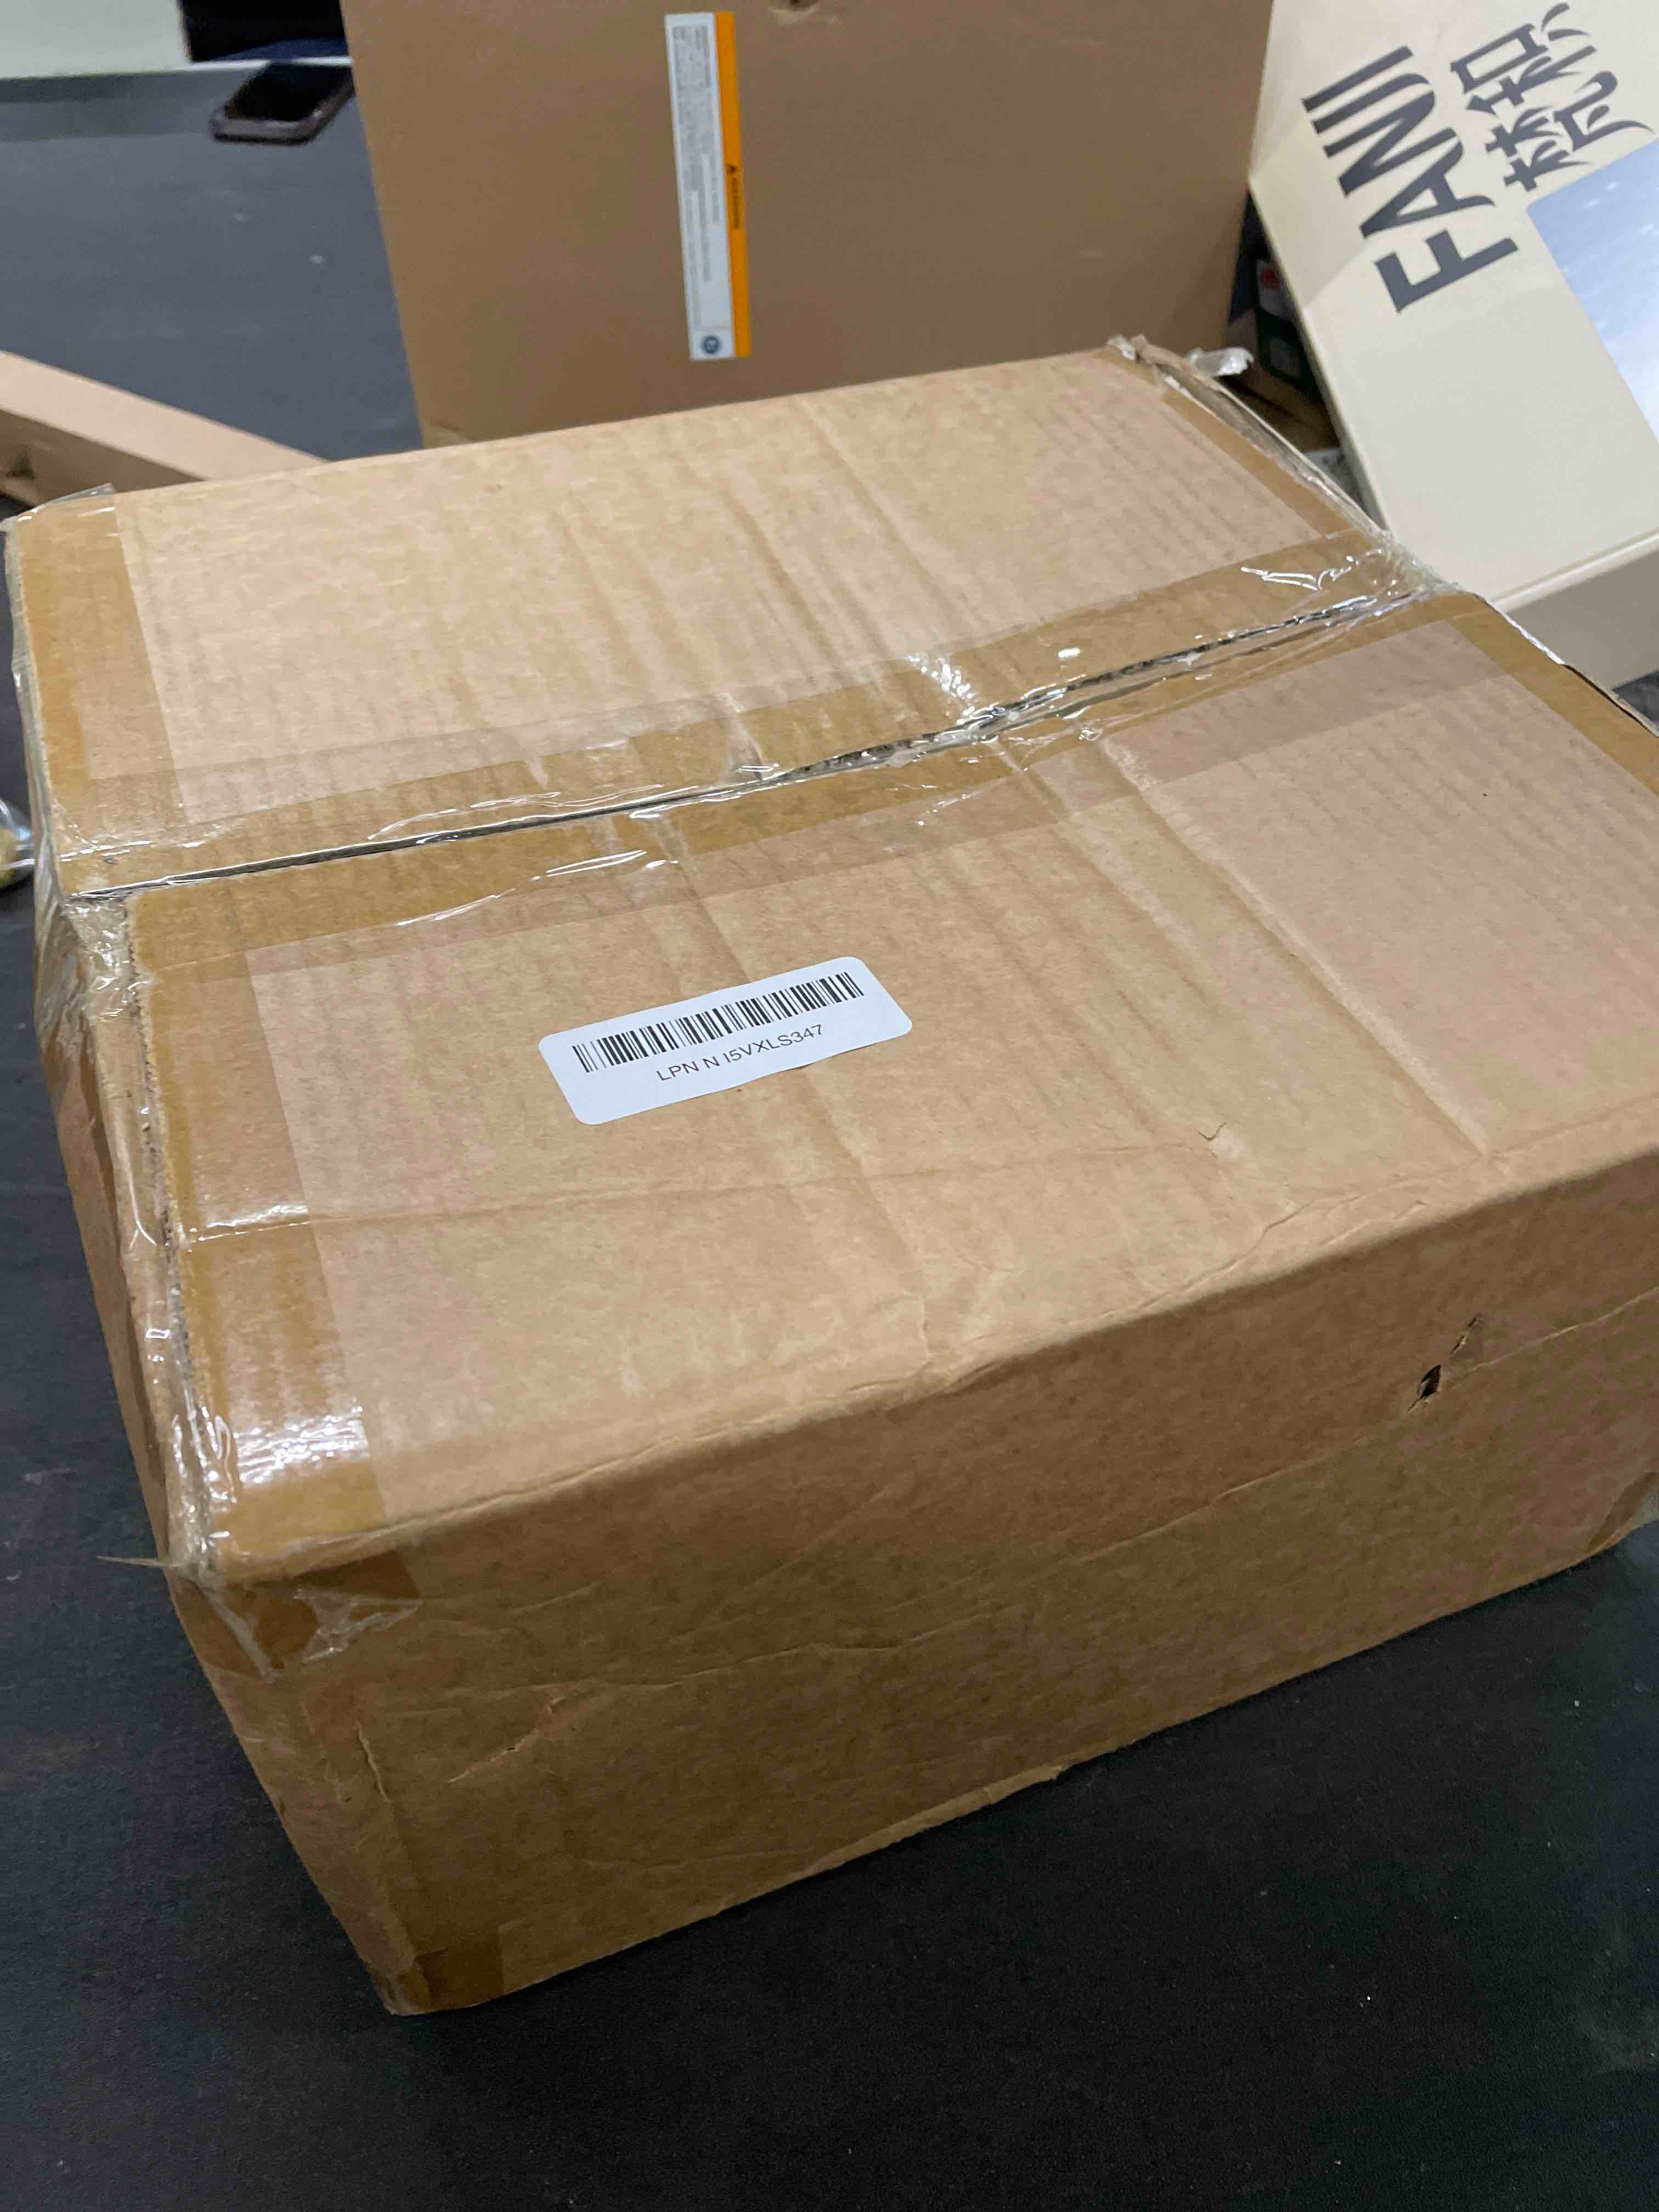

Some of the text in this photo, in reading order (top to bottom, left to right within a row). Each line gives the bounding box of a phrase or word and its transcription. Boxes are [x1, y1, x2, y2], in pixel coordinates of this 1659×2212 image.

[1301, 46, 1519, 313] FANJI
[1451, 2, 1655, 191] 梵积
[656, 1061, 699, 1081] LPN
